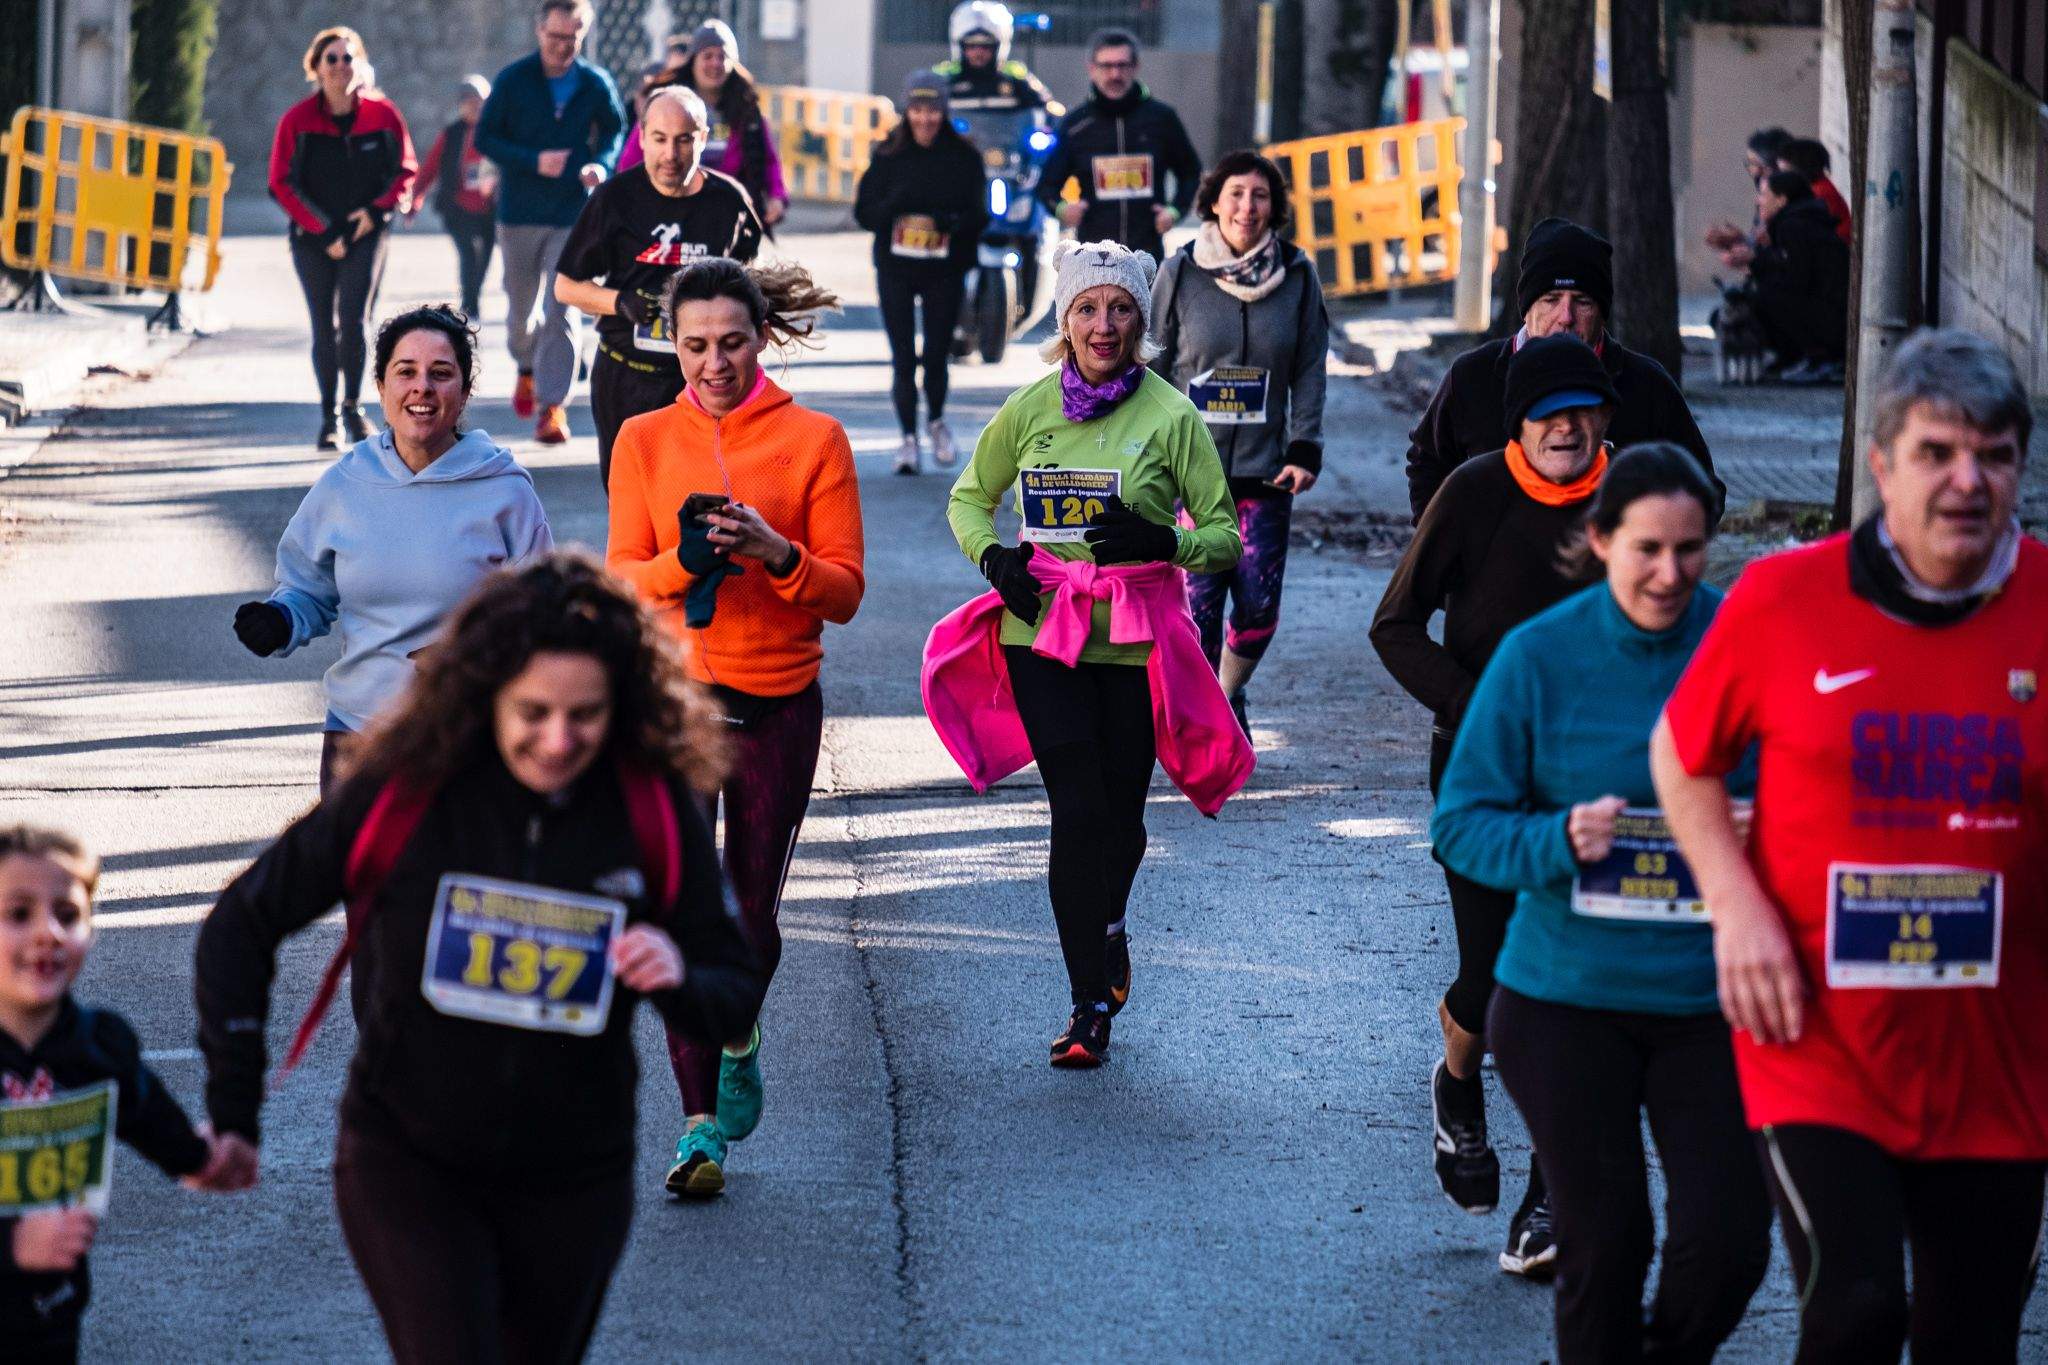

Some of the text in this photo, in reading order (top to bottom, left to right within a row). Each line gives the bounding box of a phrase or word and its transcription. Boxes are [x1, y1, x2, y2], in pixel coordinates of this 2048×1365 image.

[680, 242, 708, 256] RUN
[1220, 387, 1236, 400] 31
[1206, 401, 1247, 413] MARIA
[1042, 473, 1069, 481] MILLA
[1028, 488, 1067, 496] Recollida
[1041, 496, 1105, 526] 120
[1852, 711, 2027, 759] CURSA
[1851, 757, 2023, 812] BARÇA
[1900, 913, 1933, 939] 14
[462, 930, 589, 1001] 137
[1888, 941, 1938, 965] PEP
[0, 1140, 91, 1202] 165
